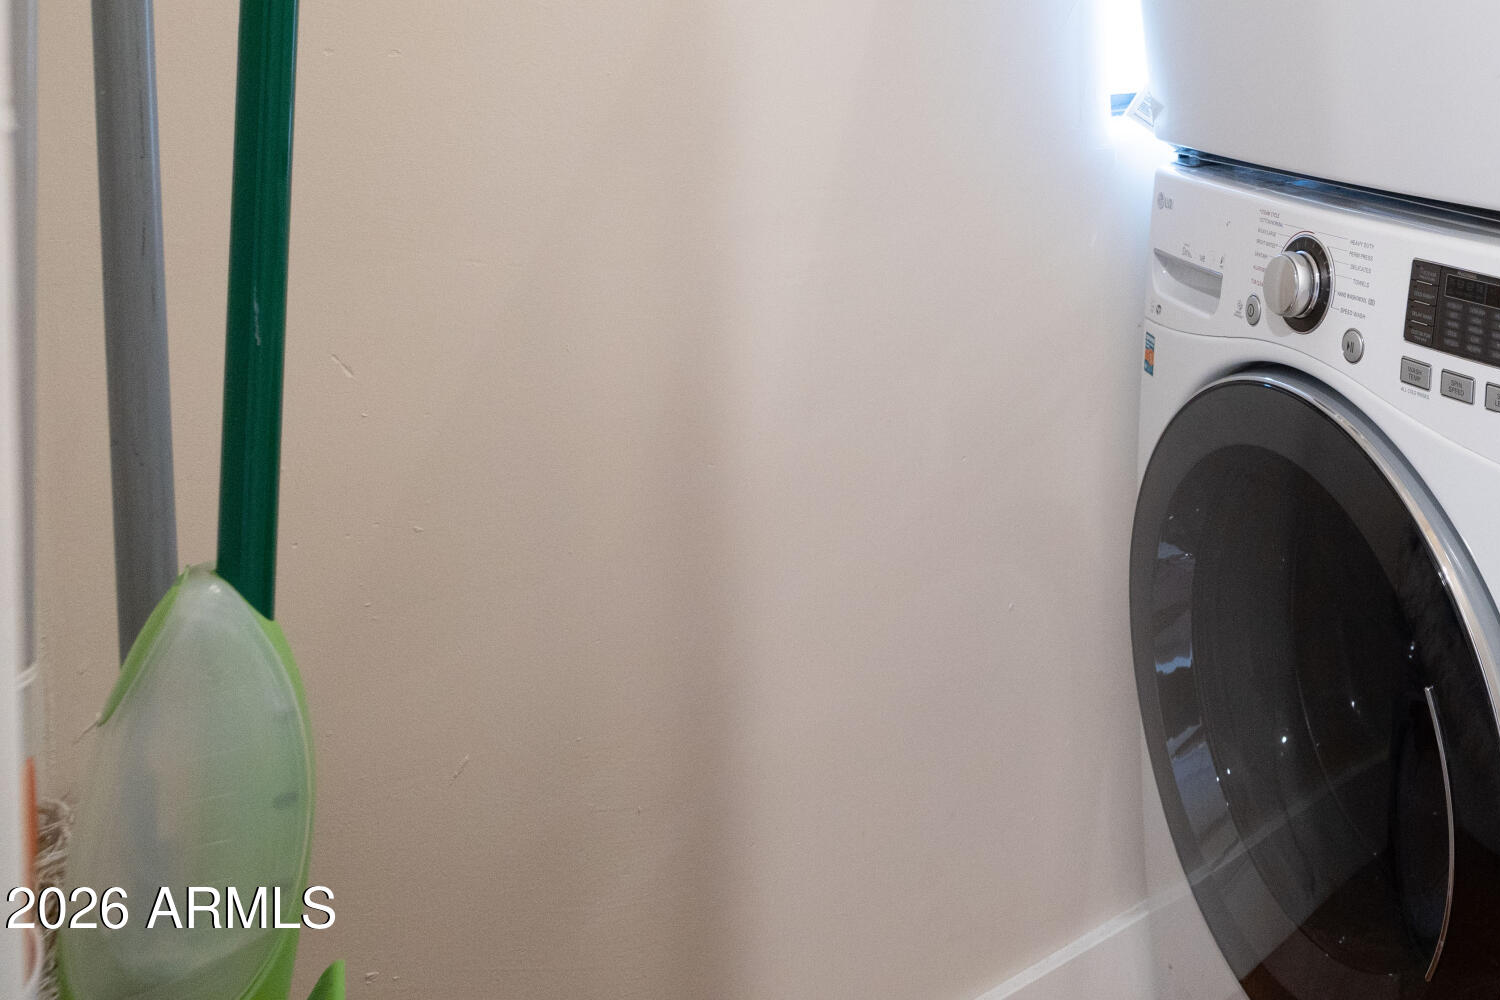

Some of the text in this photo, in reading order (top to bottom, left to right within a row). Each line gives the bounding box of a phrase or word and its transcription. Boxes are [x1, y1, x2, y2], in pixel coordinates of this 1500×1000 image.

[1408, 365, 1423, 376] WASH
[1450, 379, 1463, 389] SPIN
[1448, 385, 1465, 398] SPEED
